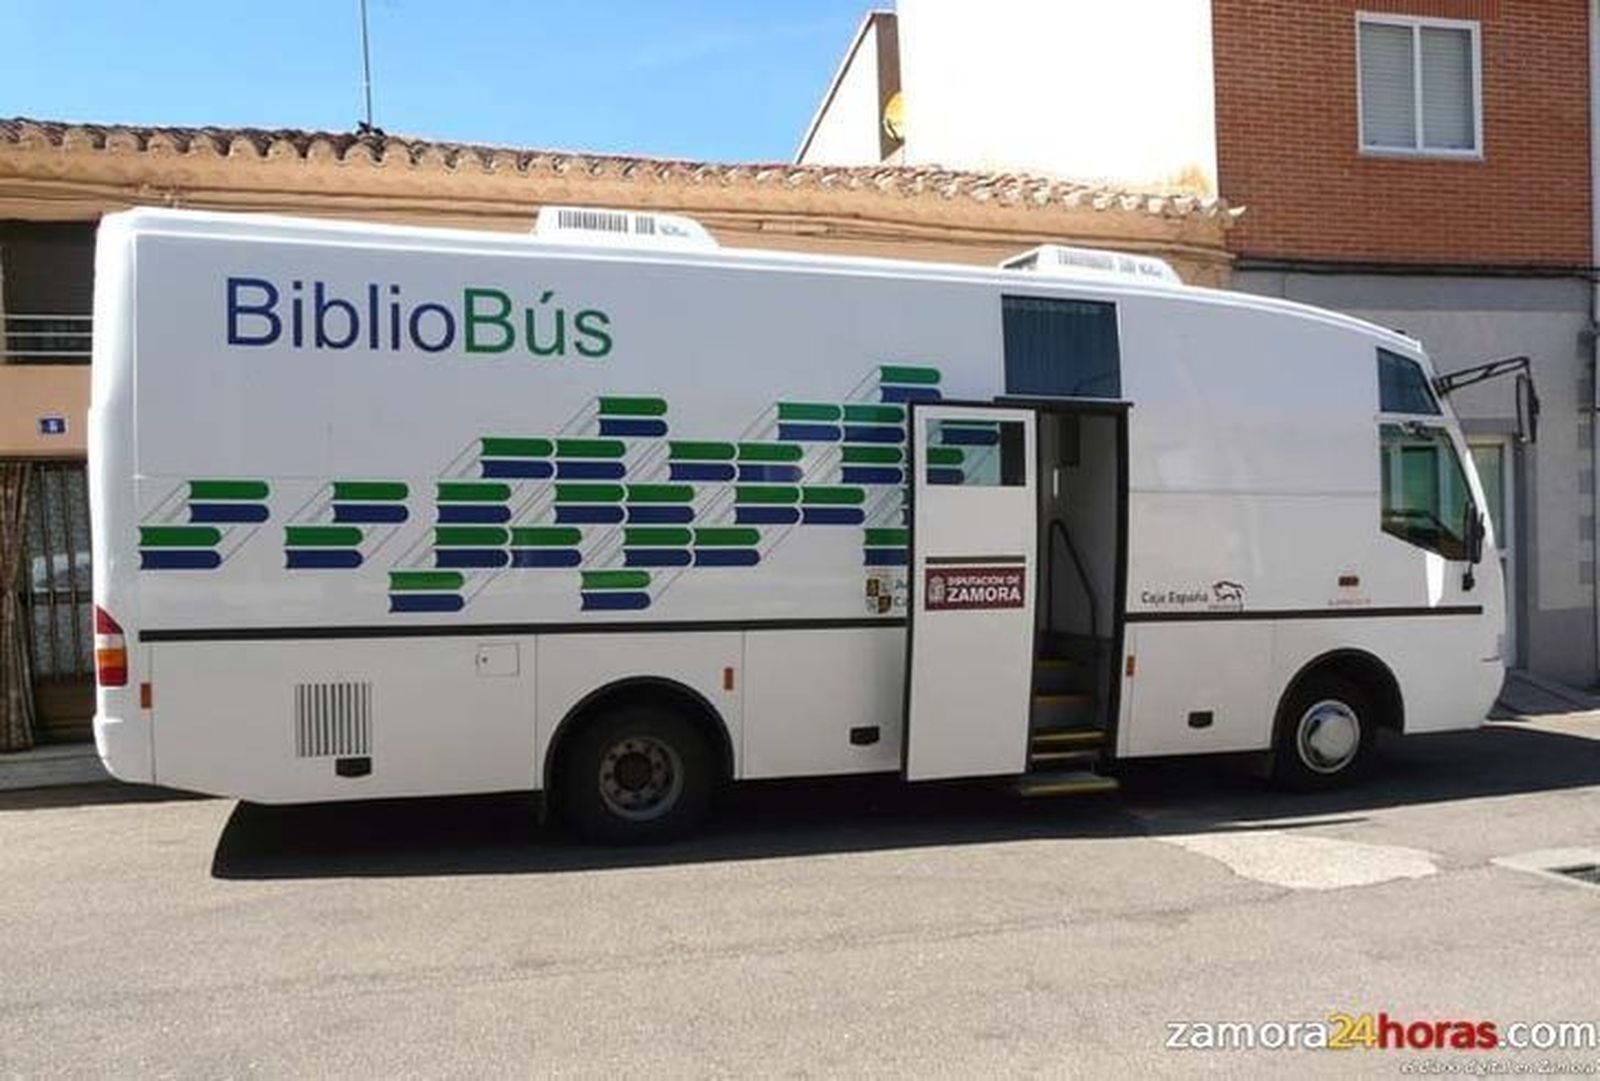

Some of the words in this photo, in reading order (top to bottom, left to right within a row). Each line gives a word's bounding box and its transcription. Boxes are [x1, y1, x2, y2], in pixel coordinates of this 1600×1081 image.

[226, 276, 614, 359] BiblioBús
[1006, 575, 1021, 585] DE
[946, 586, 1022, 602] ZAMORA
[1168, 590, 1210, 606] España
